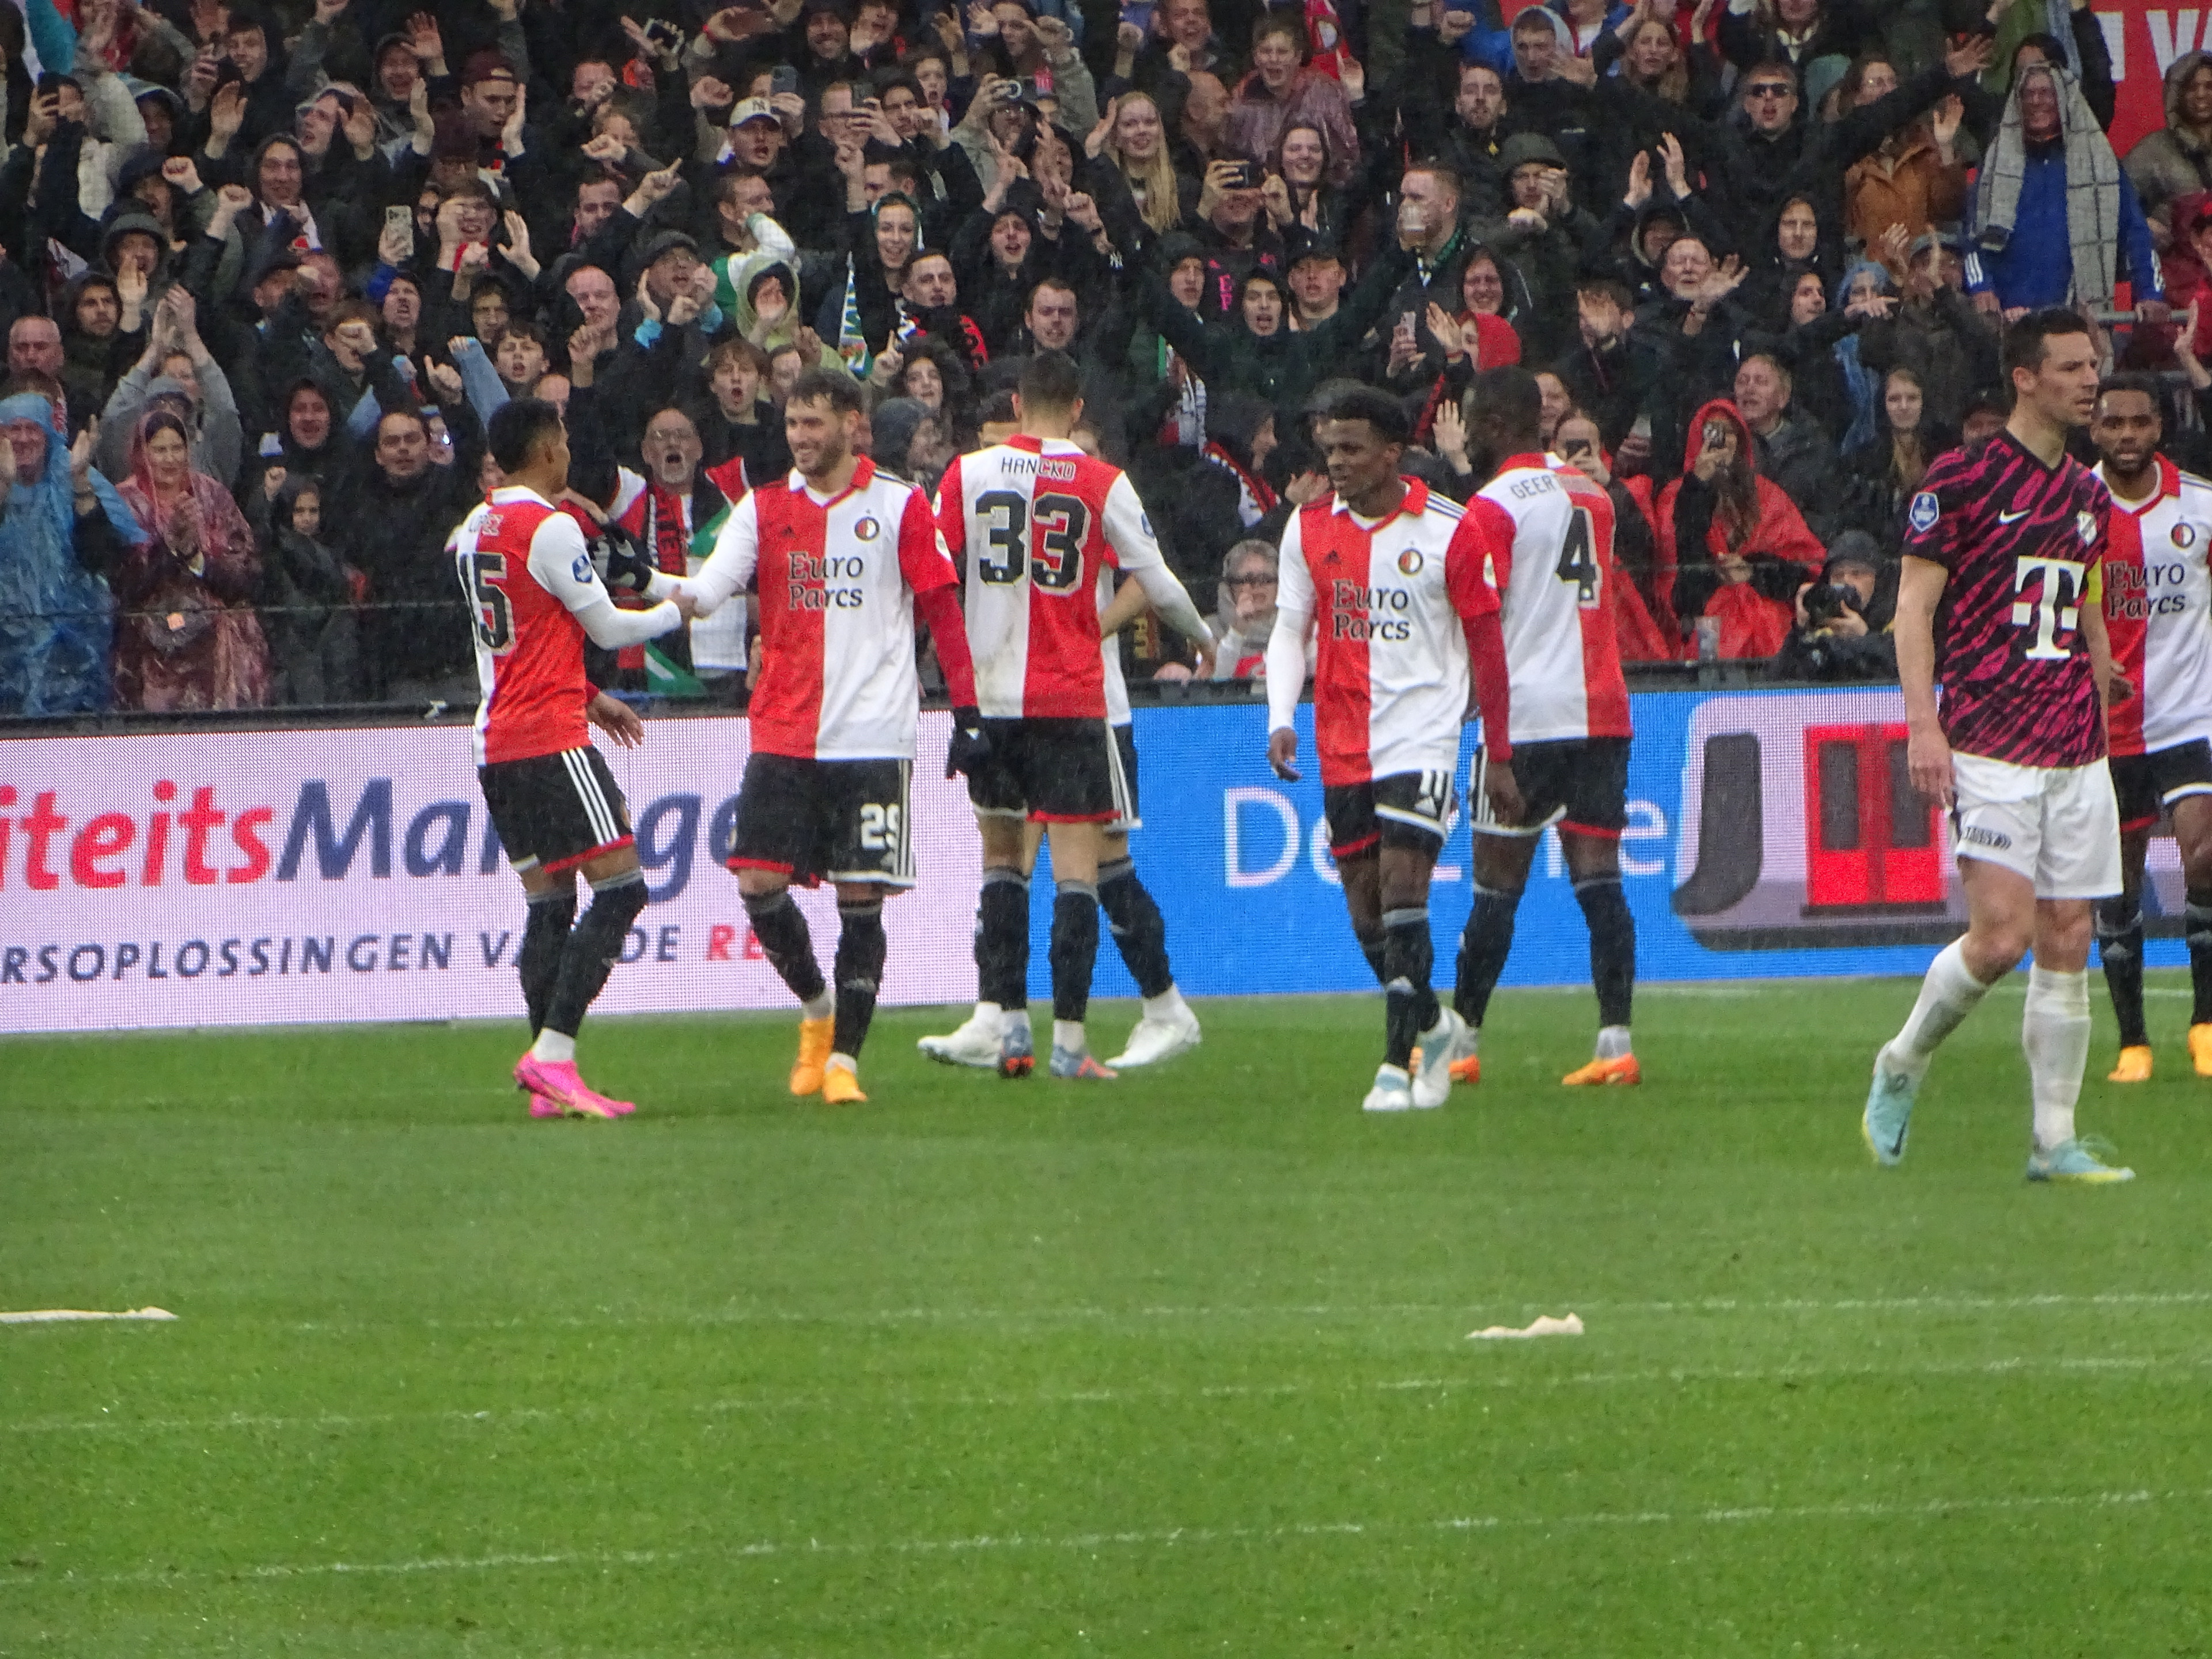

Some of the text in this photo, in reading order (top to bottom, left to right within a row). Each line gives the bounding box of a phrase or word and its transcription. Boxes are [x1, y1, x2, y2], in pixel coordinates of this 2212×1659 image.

[1001, 455, 1076, 482] HANCKO
[975, 488, 1091, 596] 33
[789, 551, 863, 580] Euro
[1556, 506, 1603, 609] 4
[2105, 562, 2185, 589] Euro
[789, 584, 863, 609] Parcs
[1332, 579, 1410, 611] Euro
[2012, 555, 2086, 661] T
[2106, 593, 2186, 619] Parcs
[1333, 612, 1410, 640] Parcs
